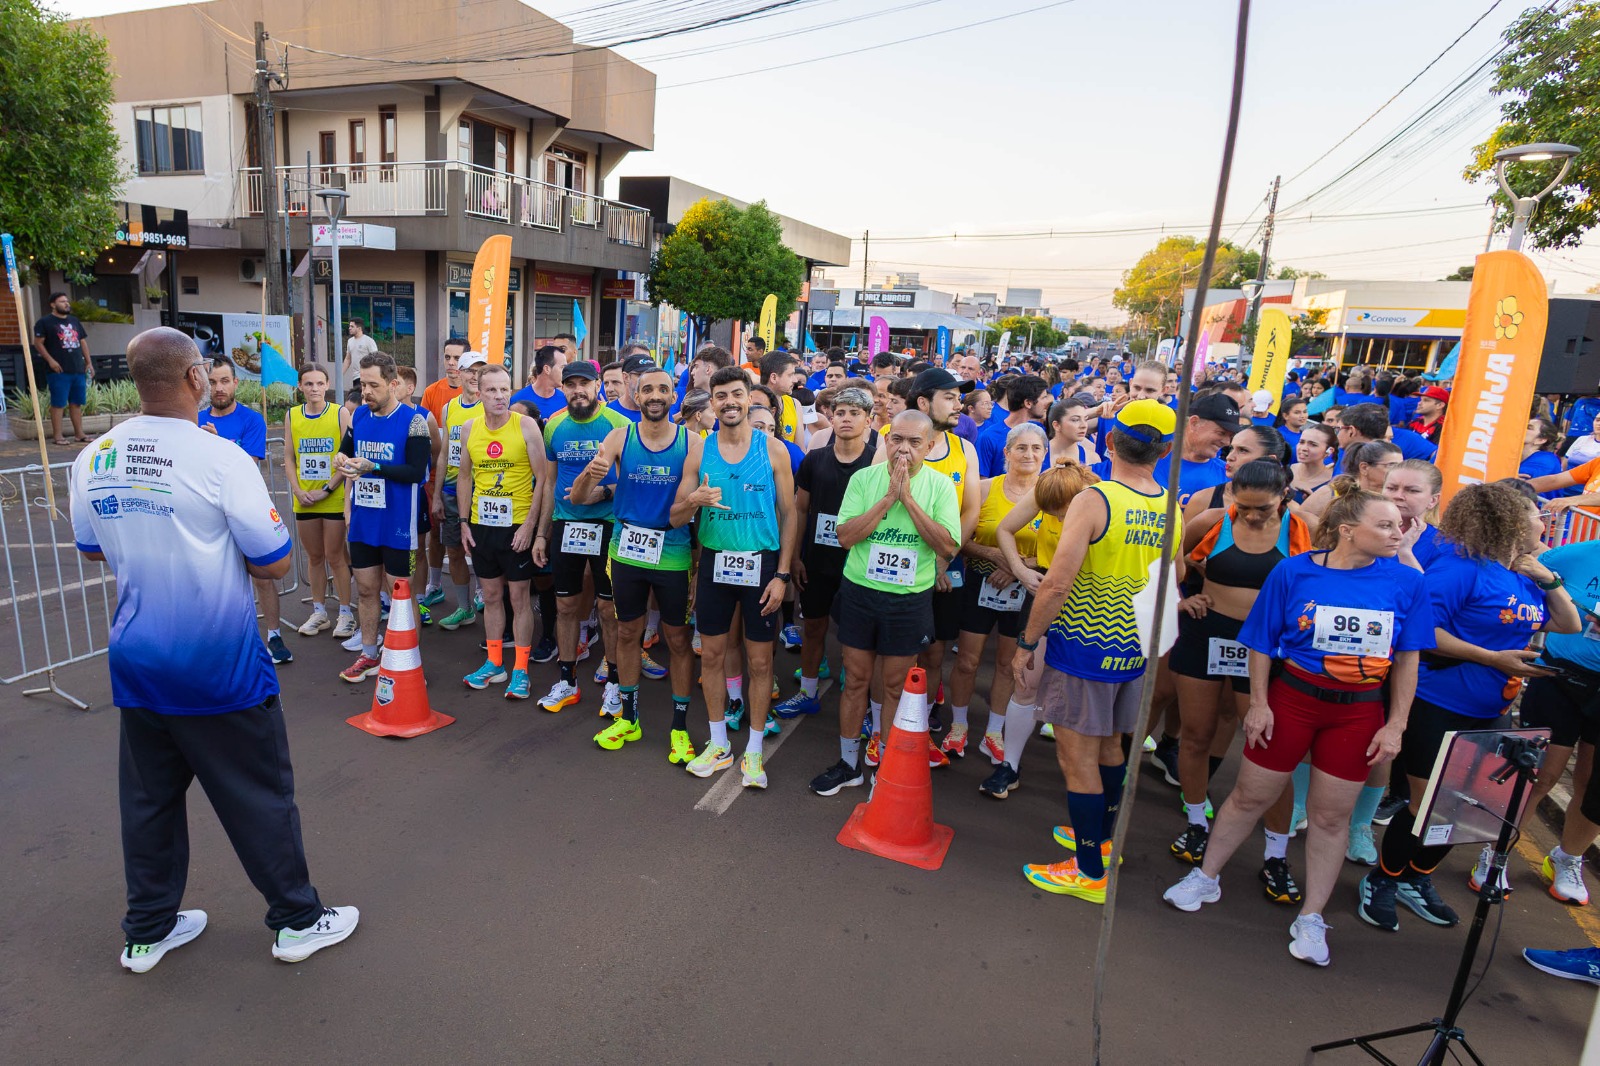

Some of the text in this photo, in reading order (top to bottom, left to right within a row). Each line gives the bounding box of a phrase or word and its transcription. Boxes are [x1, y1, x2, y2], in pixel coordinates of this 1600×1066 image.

[138, 232, 186, 246] 99851-9695
[1370, 315, 1406, 323] Correios
[1260, 351, 1274, 389] MARELO
[1458, 353, 1516, 486] LARANJA
[127, 444, 155, 452] SANTA
[298, 438, 334, 452] JAGUARS
[355, 440, 394, 460] JAGUARS
[126, 455, 173, 468] TEREZINHA
[306, 459, 316, 468] 50
[126, 466, 162, 478] DE ITAIPU
[359, 482, 374, 492] 243
[484, 502, 498, 512] 314
[824, 520, 838, 532] 21
[570, 528, 588, 540] 275
[628, 531, 648, 546] 307
[723, 555, 744, 568] 129
[878, 552, 899, 568] 312
[1334, 615, 1360, 632] 96
[1219, 646, 1248, 659] 158
[1101, 656, 1144, 670] ATLETA
